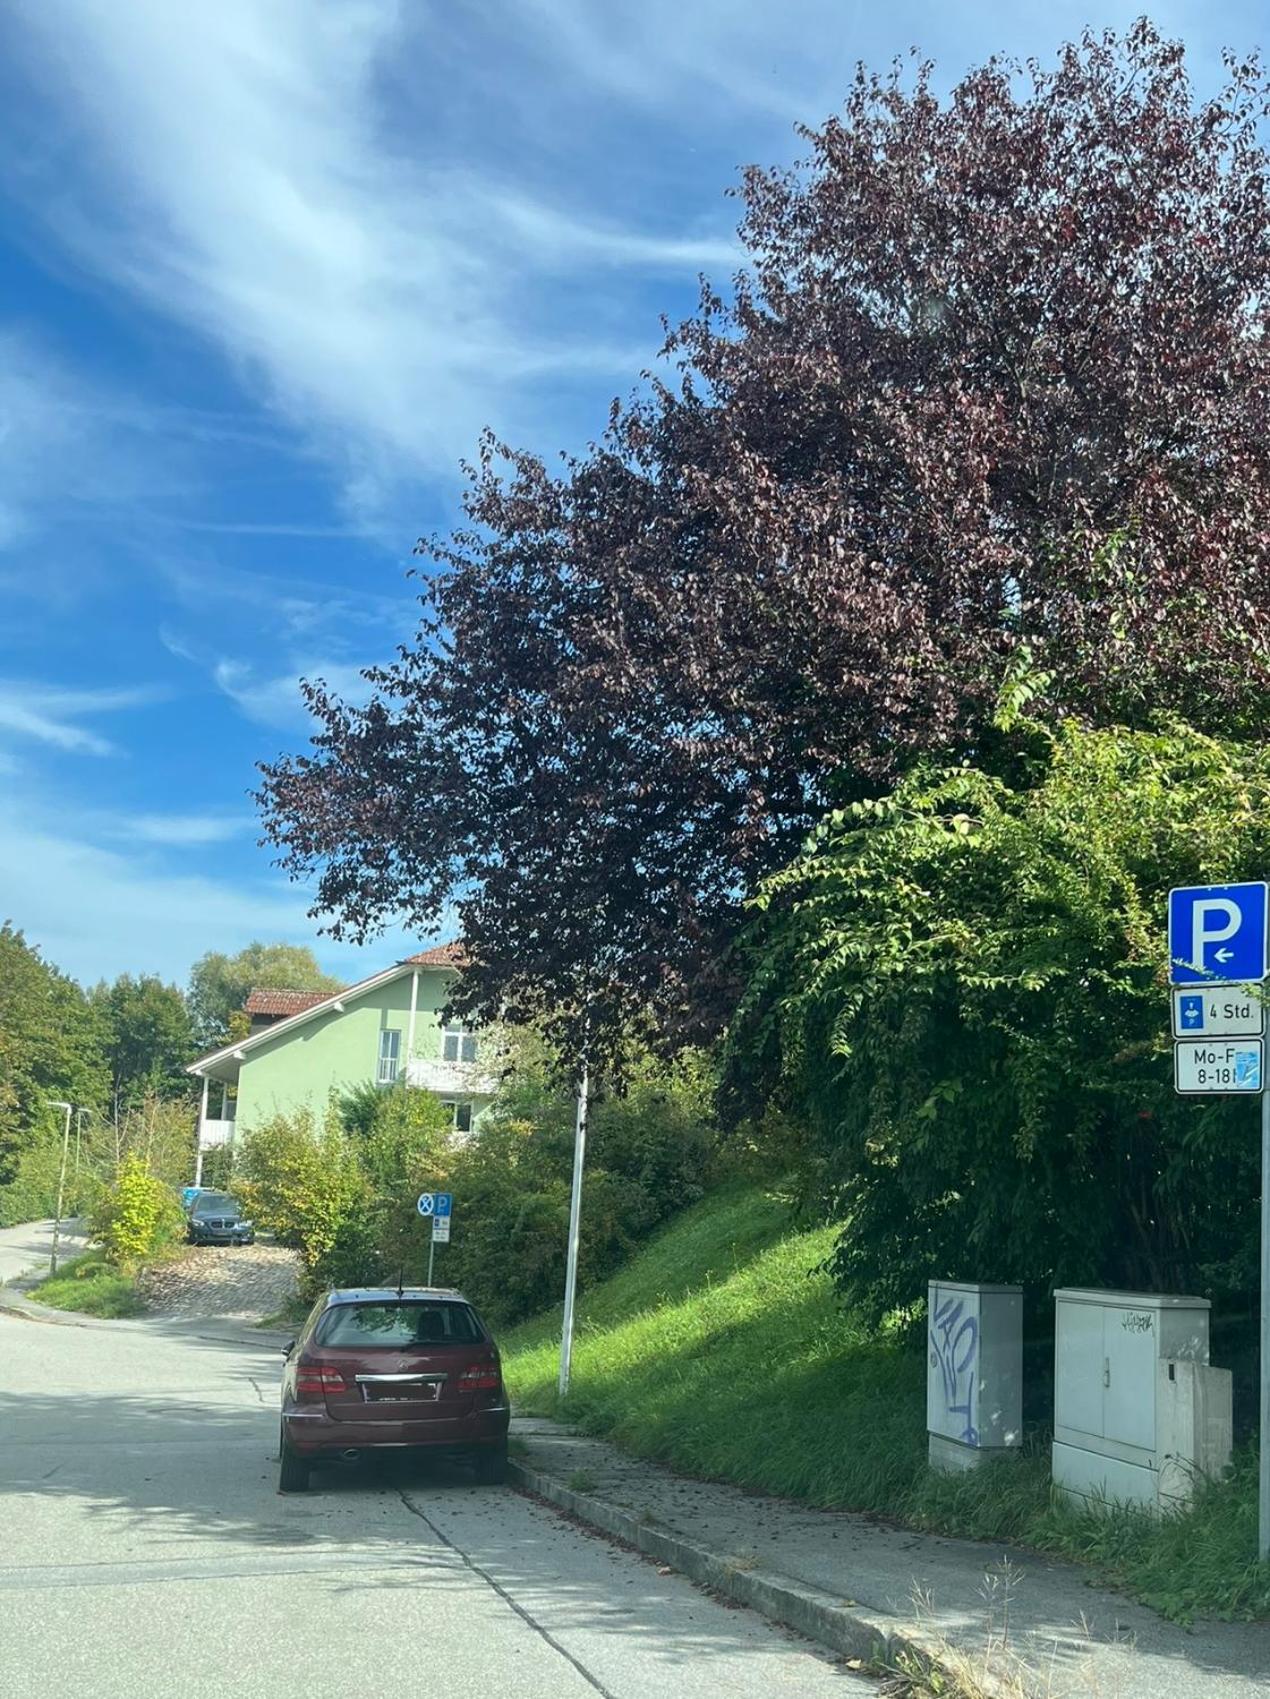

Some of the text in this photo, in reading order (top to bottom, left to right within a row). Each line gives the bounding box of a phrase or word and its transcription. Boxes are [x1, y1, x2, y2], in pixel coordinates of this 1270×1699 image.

[1192, 898, 1243, 971] P
[1209, 1003, 1255, 1019] 4 Std.
[1194, 1048, 1236, 1065] Mo-F
[437, 1196, 447, 1213] P
